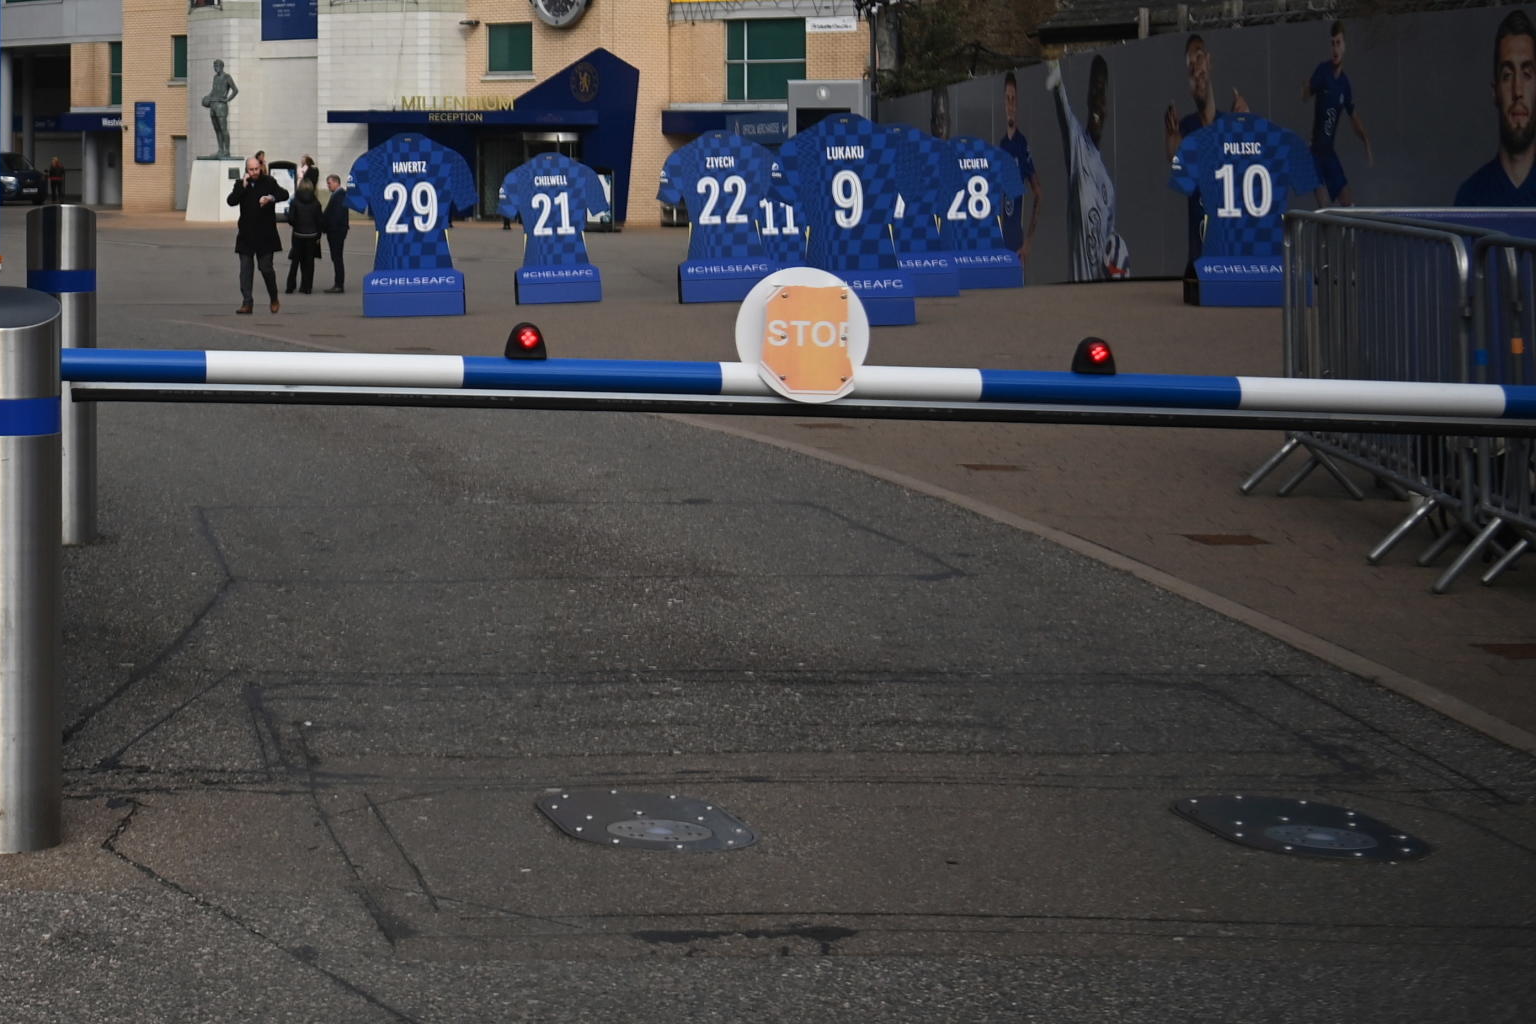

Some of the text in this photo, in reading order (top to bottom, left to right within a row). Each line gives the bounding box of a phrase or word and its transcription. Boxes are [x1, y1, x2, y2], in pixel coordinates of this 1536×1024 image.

[401, 95, 515, 112] MILLENNIUM
[428, 113, 483, 123] RECEPTION
[826, 145, 865, 160] LUKAKU
[1223, 142, 1263, 155] PULISIC
[392, 160, 427, 174] HAVERTZ
[705, 155, 735, 169] ZIYECH
[958, 157, 990, 170] LICUETA
[534, 174, 568, 187] CHILWELL
[1214, 163, 1273, 218] 10
[696, 175, 749, 225] 22
[831, 169, 864, 229] 9
[383, 181, 438, 234] 29
[531, 191, 576, 237] 21
[759, 197, 800, 236] 11
[898, 259, 949, 269] LSEAFC
[954, 254, 1013, 266] HELSEAFC
[522, 268, 593, 279] #CHELSEAFC
[687, 263, 769, 275] #CHELSEAFC
[370, 275, 456, 287] #CHELSEAFC
